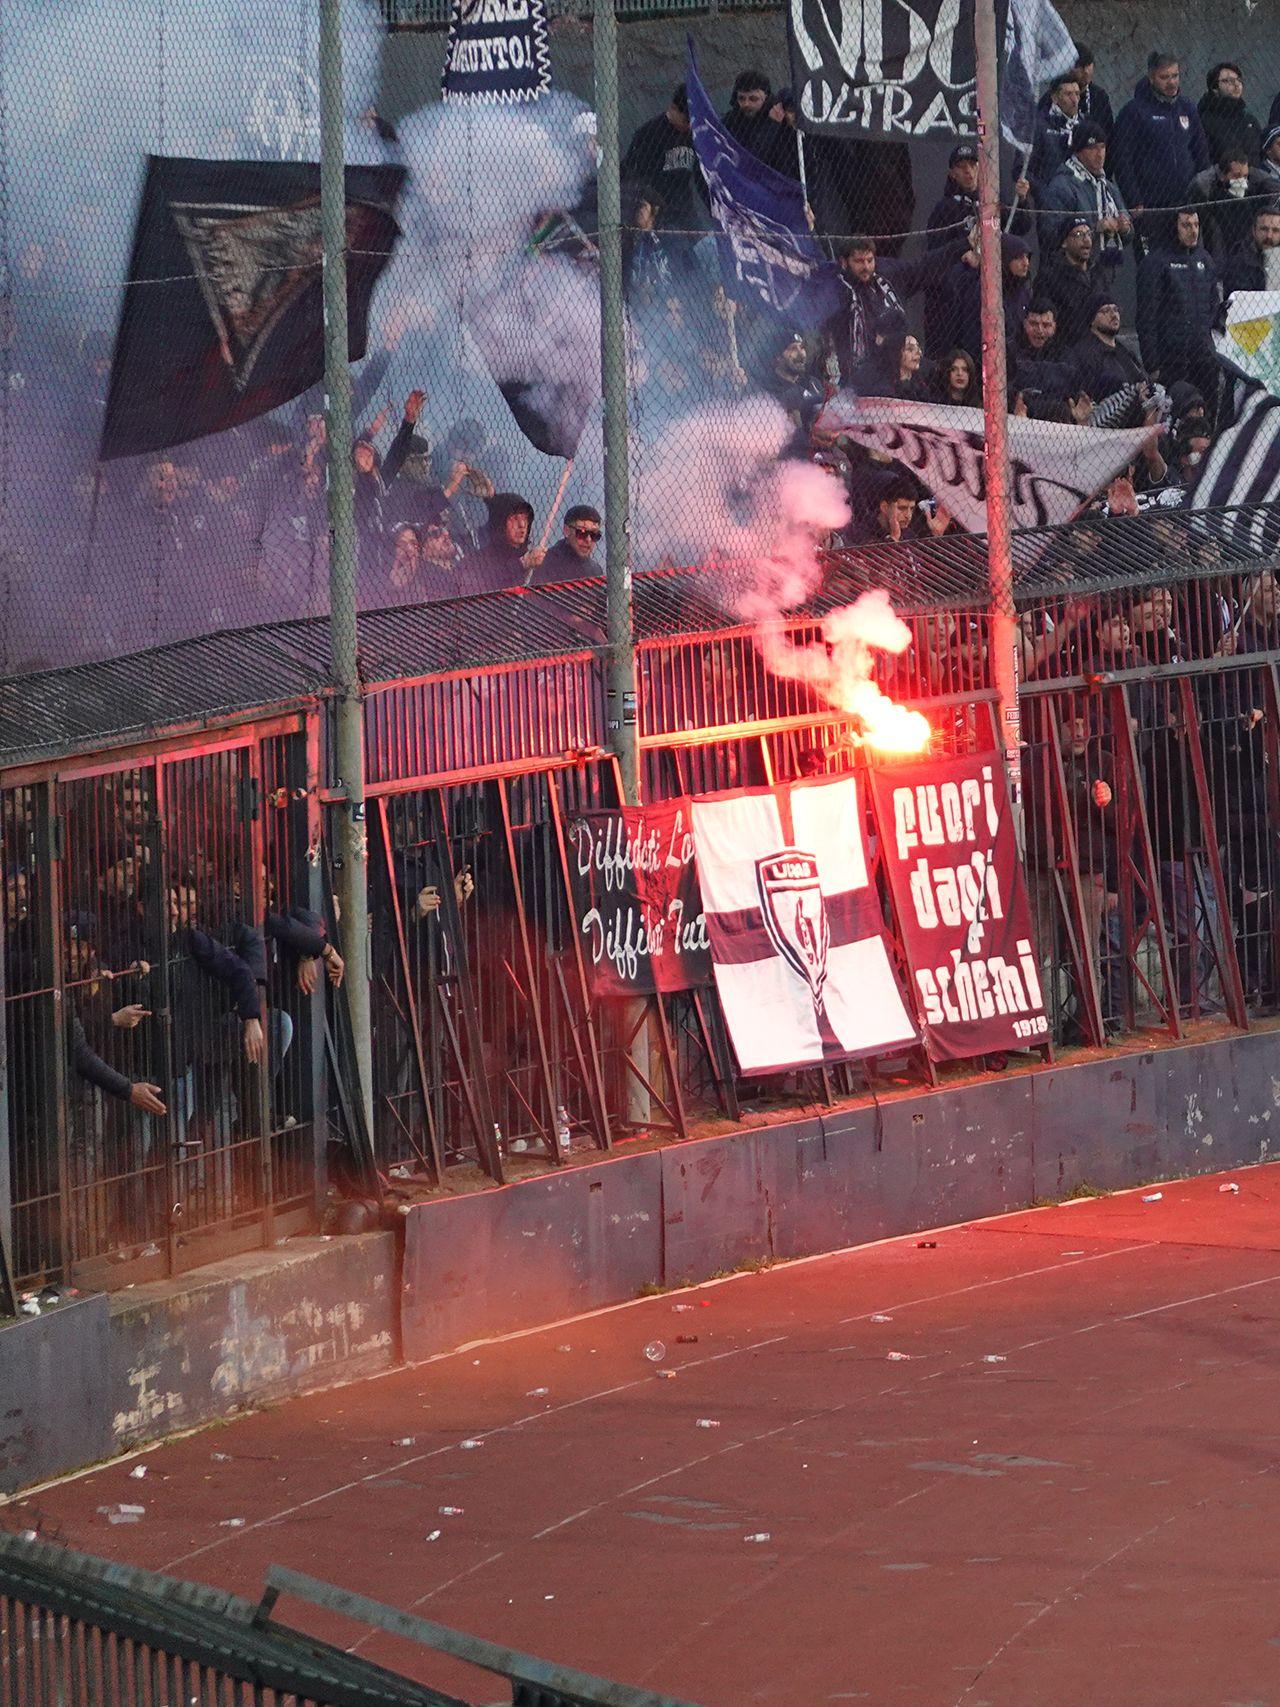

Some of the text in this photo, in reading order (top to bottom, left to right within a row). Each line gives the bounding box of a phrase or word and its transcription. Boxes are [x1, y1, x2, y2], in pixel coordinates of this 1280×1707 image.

[569, 817, 662, 892] Diffidati
[893, 765, 999, 860] fuori
[916, 939, 1044, 1025] schemi
